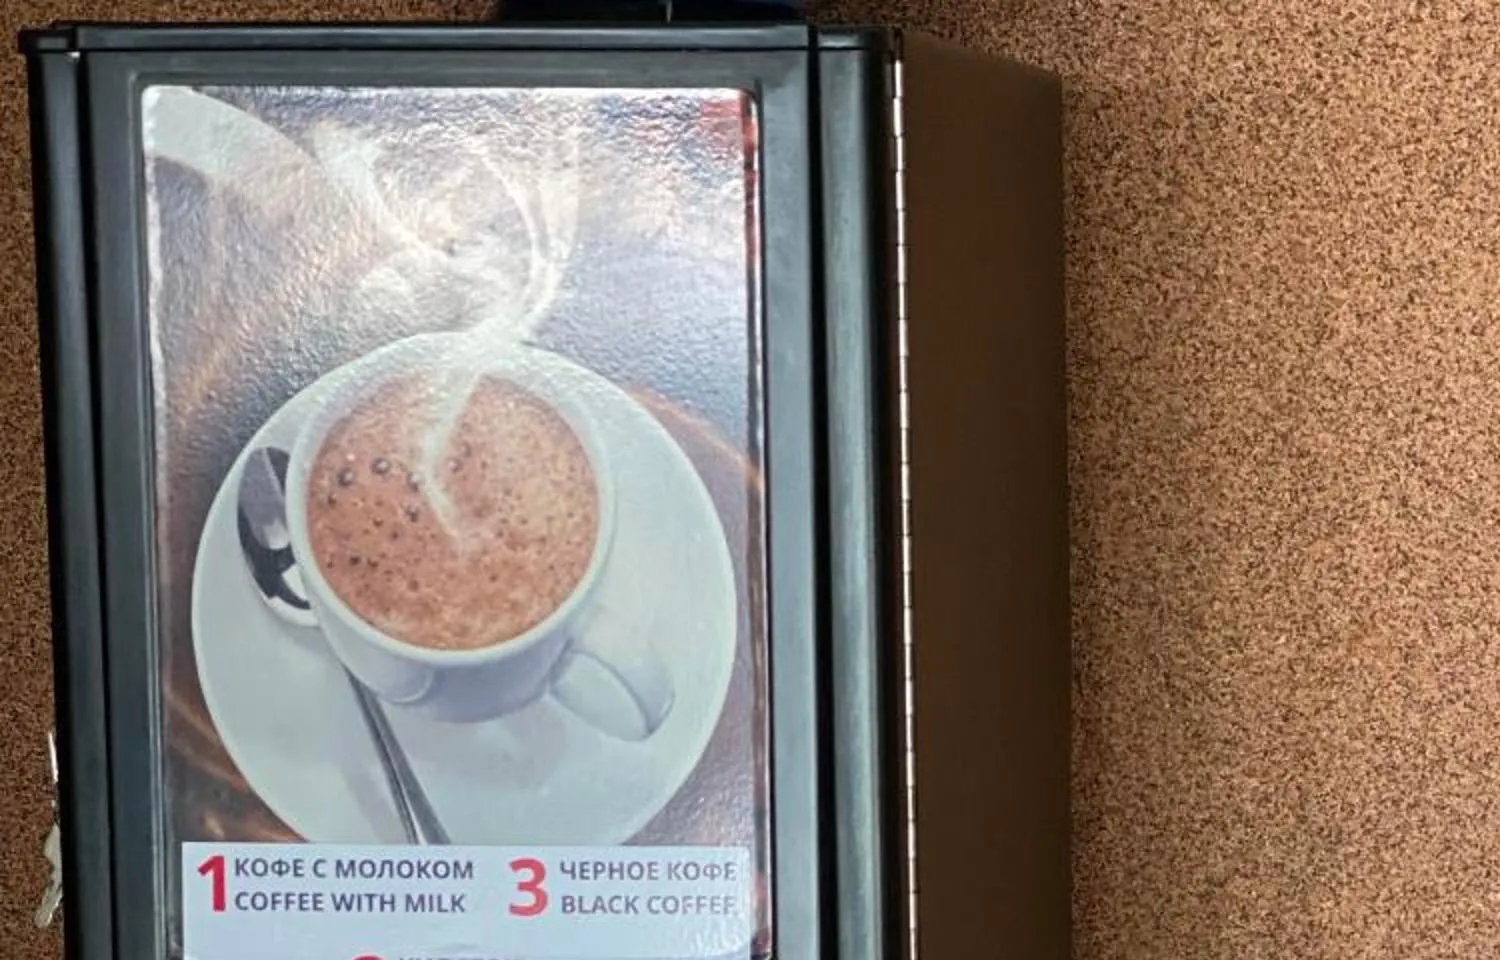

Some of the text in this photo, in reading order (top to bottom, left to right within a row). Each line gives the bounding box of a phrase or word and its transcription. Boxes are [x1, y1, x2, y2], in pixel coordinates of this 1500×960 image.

[235, 858, 474, 880] КОФЕ С МОЛОКОМ
[560, 861, 737, 882] ЧЕРНОЕ КОФЕ
[198, 855, 226, 912] 1
[508, 858, 548, 917] 3
[234, 891, 466, 913] COFFEE WITH MILK
[561, 896, 737, 916] BLACK COFFEE
